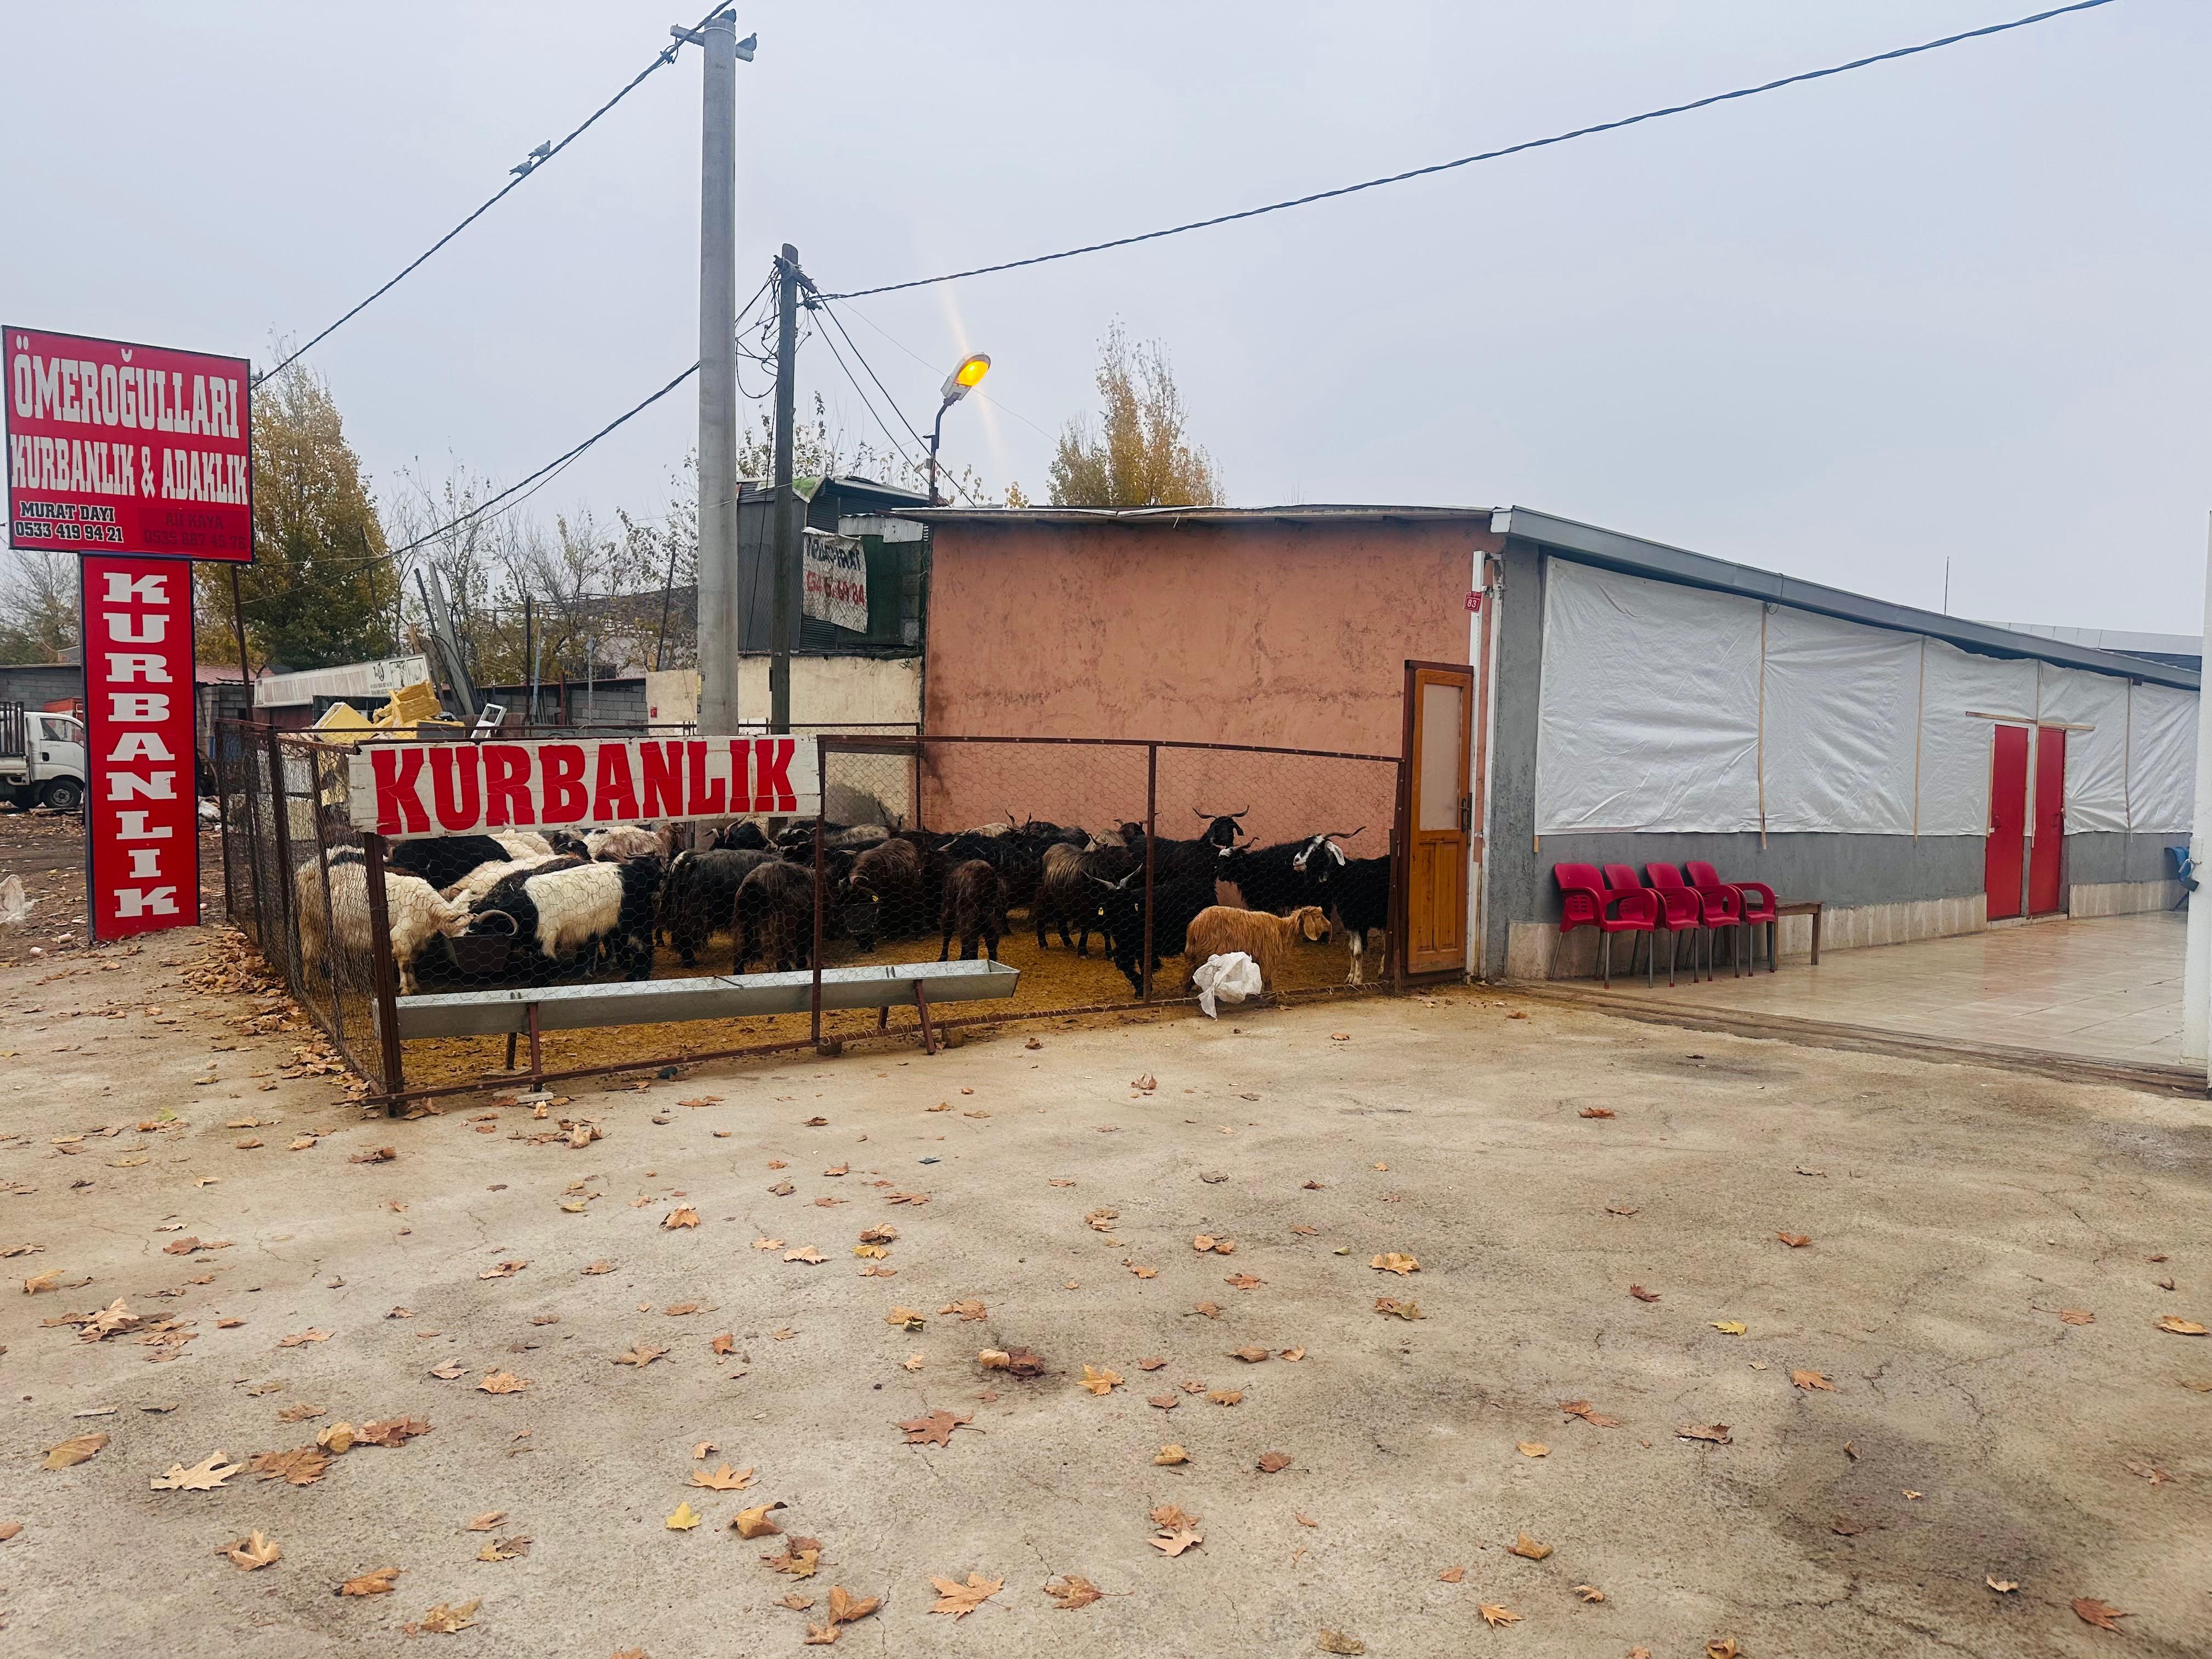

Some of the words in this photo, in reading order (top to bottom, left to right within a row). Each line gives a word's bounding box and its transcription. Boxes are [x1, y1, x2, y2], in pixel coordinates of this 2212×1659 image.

[14, 335, 239, 438] ÖMEROĞULLARI
[10, 434, 135, 496] KURBANLIK
[141, 446, 155, 498] &
[162, 448, 248, 505] ADAKLIK
[14, 521, 52, 538] 0533
[55, 522, 82, 540] 419
[83, 524, 104, 542] 94
[106, 526, 124, 543] 21
[20, 501, 76, 520] MURAT
[79, 505, 115, 523] DAYI
[1468, 599, 1477, 608] 83
[103, 572, 179, 917] KURBANLIK
[370, 739, 798, 836] KURBANLIK
